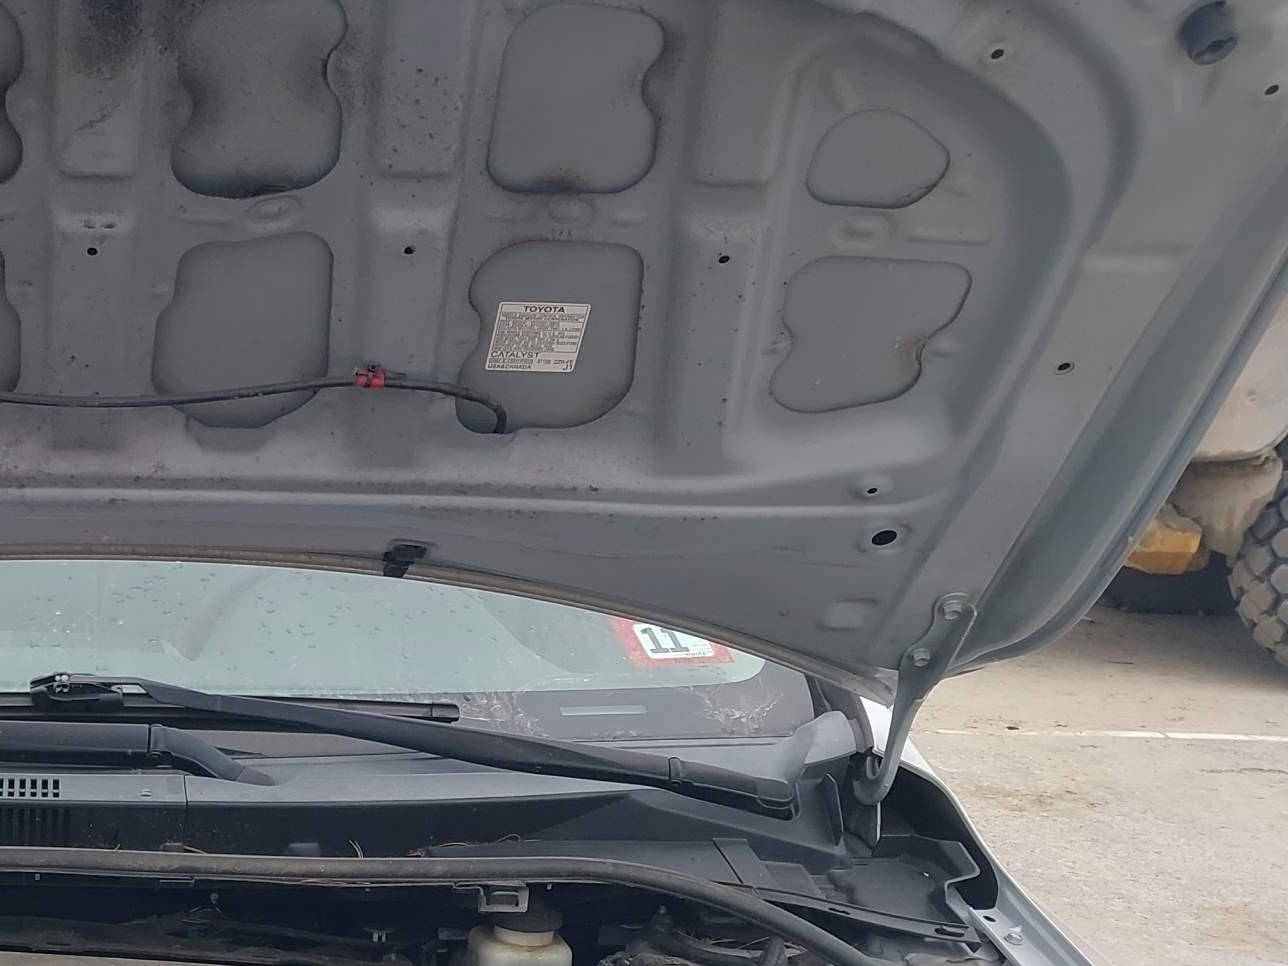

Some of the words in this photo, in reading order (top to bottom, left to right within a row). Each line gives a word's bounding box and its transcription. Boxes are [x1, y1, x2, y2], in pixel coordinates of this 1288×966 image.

[523, 305, 566, 313] TOYOTA
[490, 351, 540, 359] CATALYST
[640, 627, 690, 653] 11
